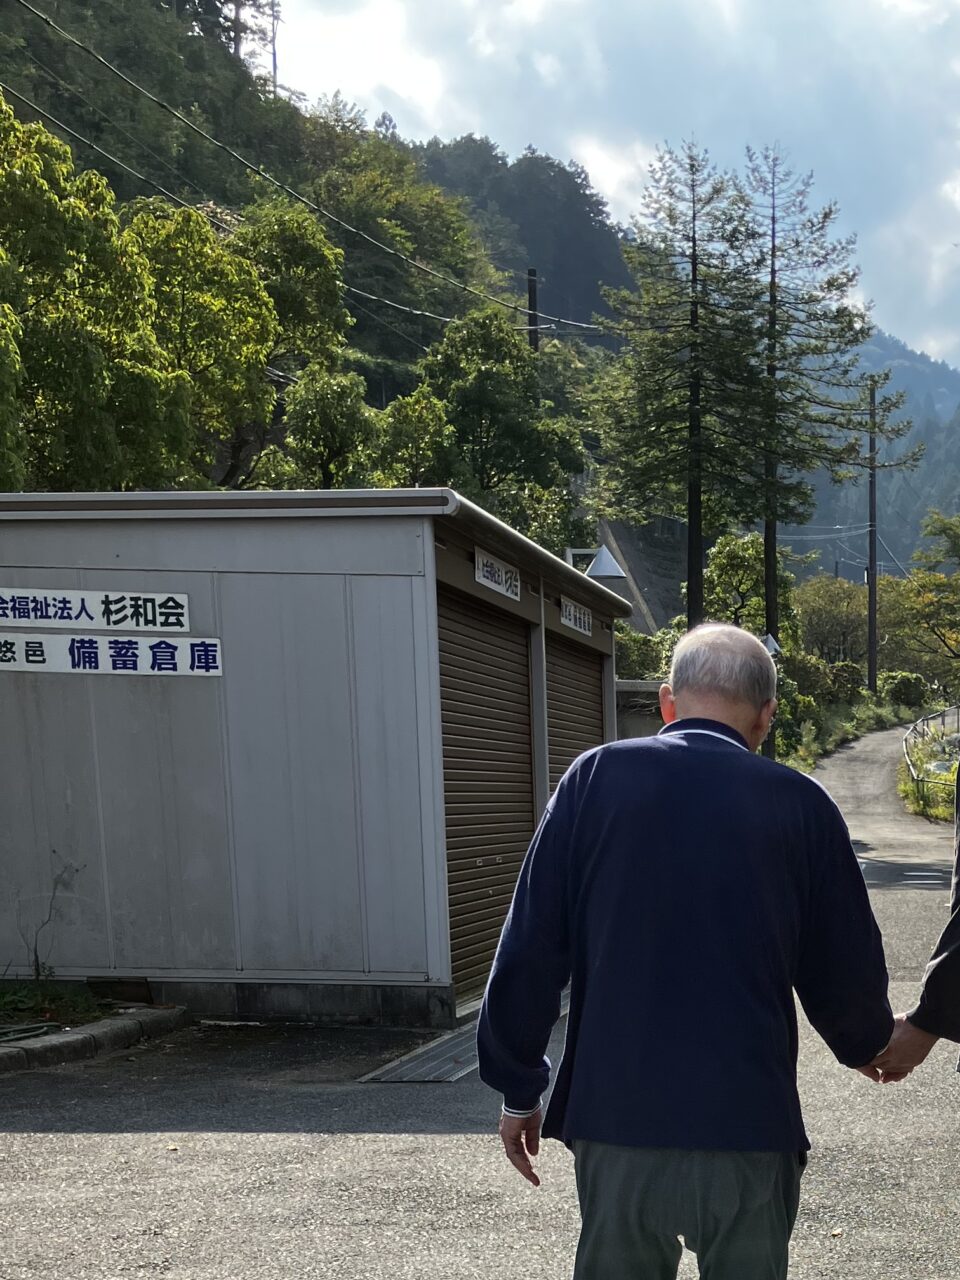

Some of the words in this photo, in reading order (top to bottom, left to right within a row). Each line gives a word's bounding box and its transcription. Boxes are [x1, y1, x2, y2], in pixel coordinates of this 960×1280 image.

[101, 595, 185, 628] 杉和会
[68, 638, 219, 672] 備蓄倉庫
